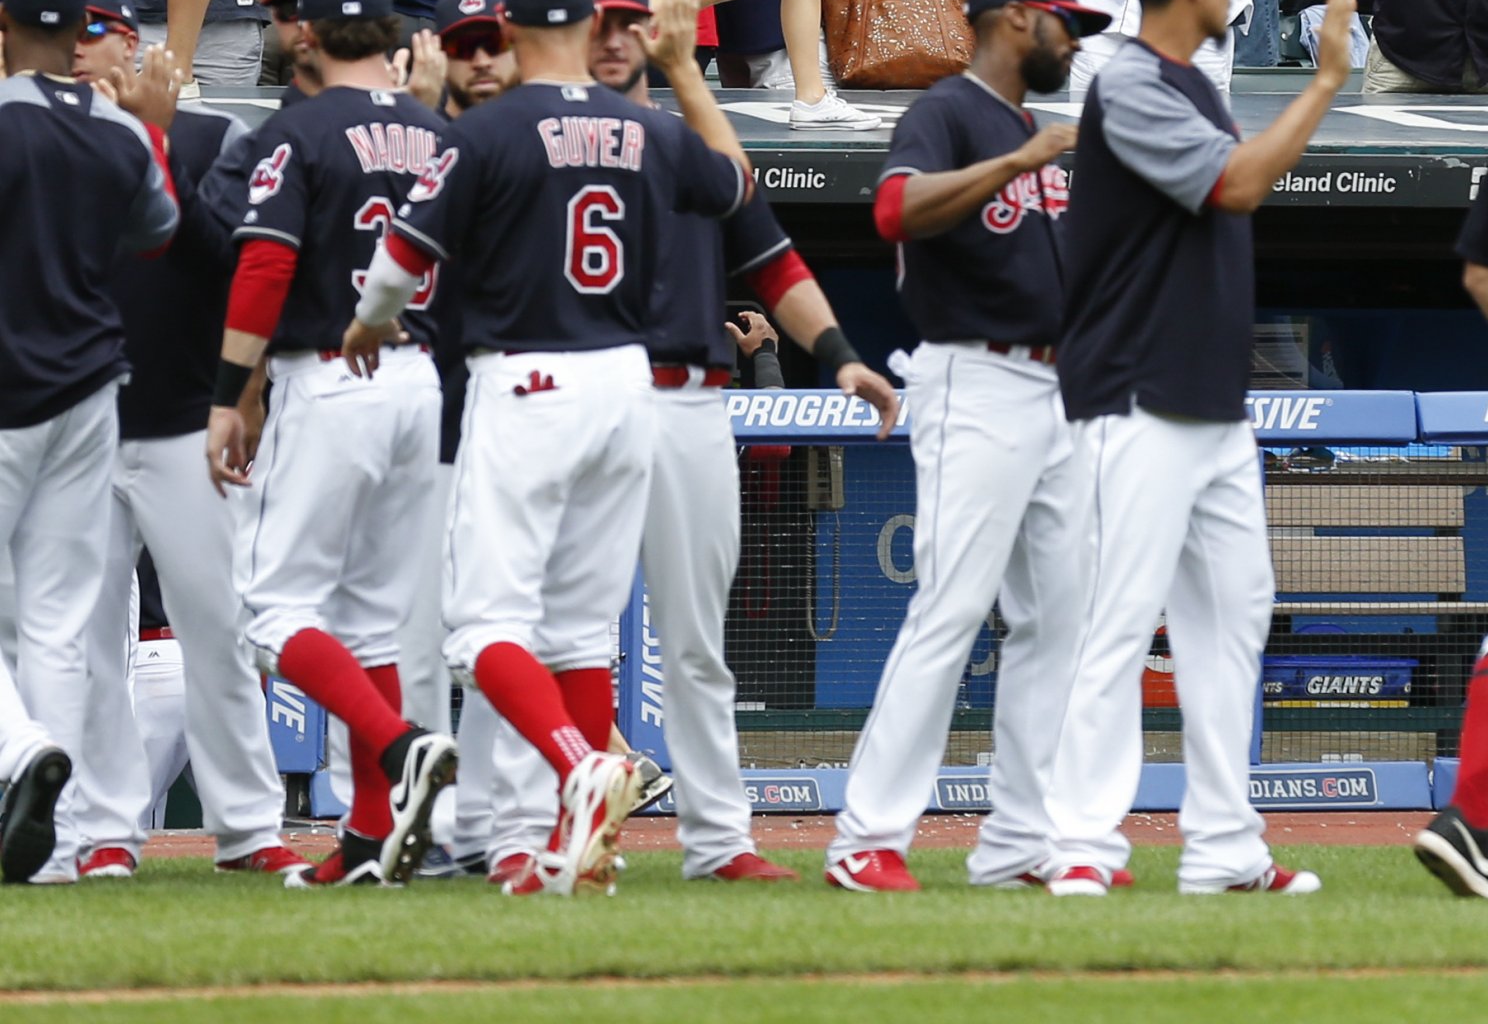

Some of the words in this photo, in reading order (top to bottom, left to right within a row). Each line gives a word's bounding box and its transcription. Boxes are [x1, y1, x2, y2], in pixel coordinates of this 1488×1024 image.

[537, 116, 645, 172] GUYER
[763, 167, 827, 190] Clinic
[1271, 172, 1332, 193] eland
[1335, 172, 1398, 193] Clinic
[563, 184, 626, 296] 6
[1307, 675, 1383, 695] GIANTS
[1250, 777, 1370, 799] DIANS.COM
